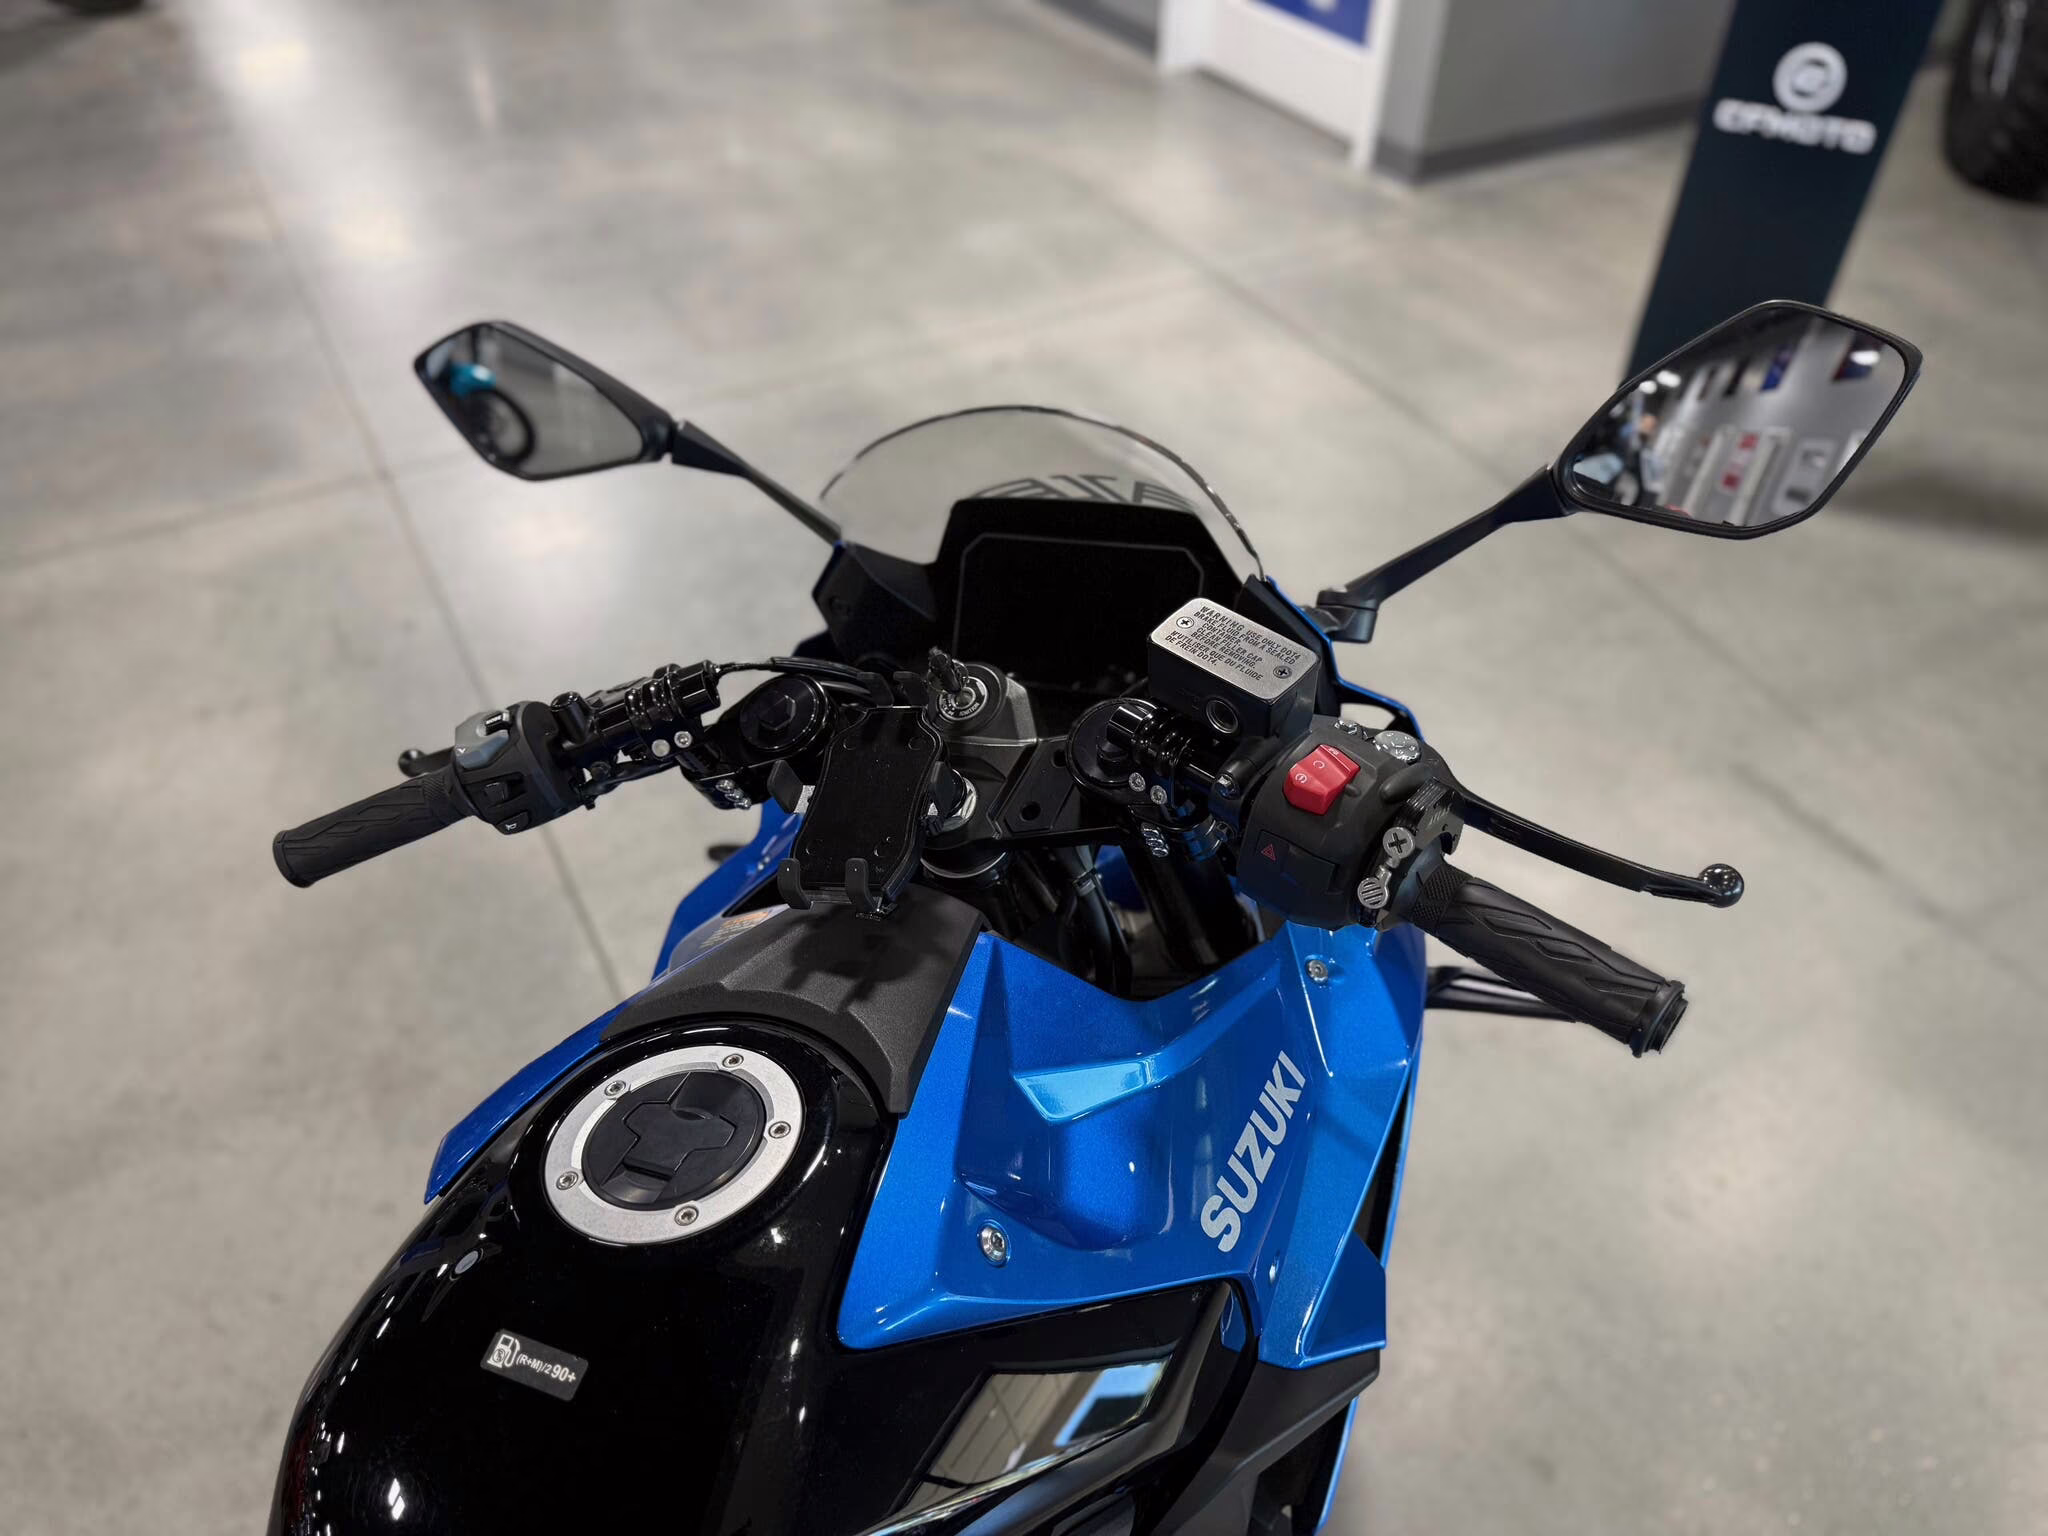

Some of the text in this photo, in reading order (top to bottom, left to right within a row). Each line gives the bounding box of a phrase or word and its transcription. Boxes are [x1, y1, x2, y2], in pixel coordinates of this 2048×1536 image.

[1165, 634, 1217, 666] DE FREIN DOT4.
[1191, 631, 1256, 669] BEFORE REMOVING.
[1194, 611, 1219, 626] BRAKE
[1217, 622, 1240, 637] FLUID
[1239, 633, 1261, 647] FROM
[1265, 648, 1296, 665] SEALED
[1196, 627, 1222, 642] CLEAN
[1219, 638, 1247, 655] FILLER
[1200, 606, 1301, 659] WARNING USE ONLY DOT4
[1170, 630, 1210, 653] N'UTILISER
[1209, 650, 1225, 661] QUE
[1234, 663, 1264, 680] FLUIDE
[1200, 1050, 1306, 1253] SUZUKI
[516, 1353, 577, 1382] (R+M)/2 90+
